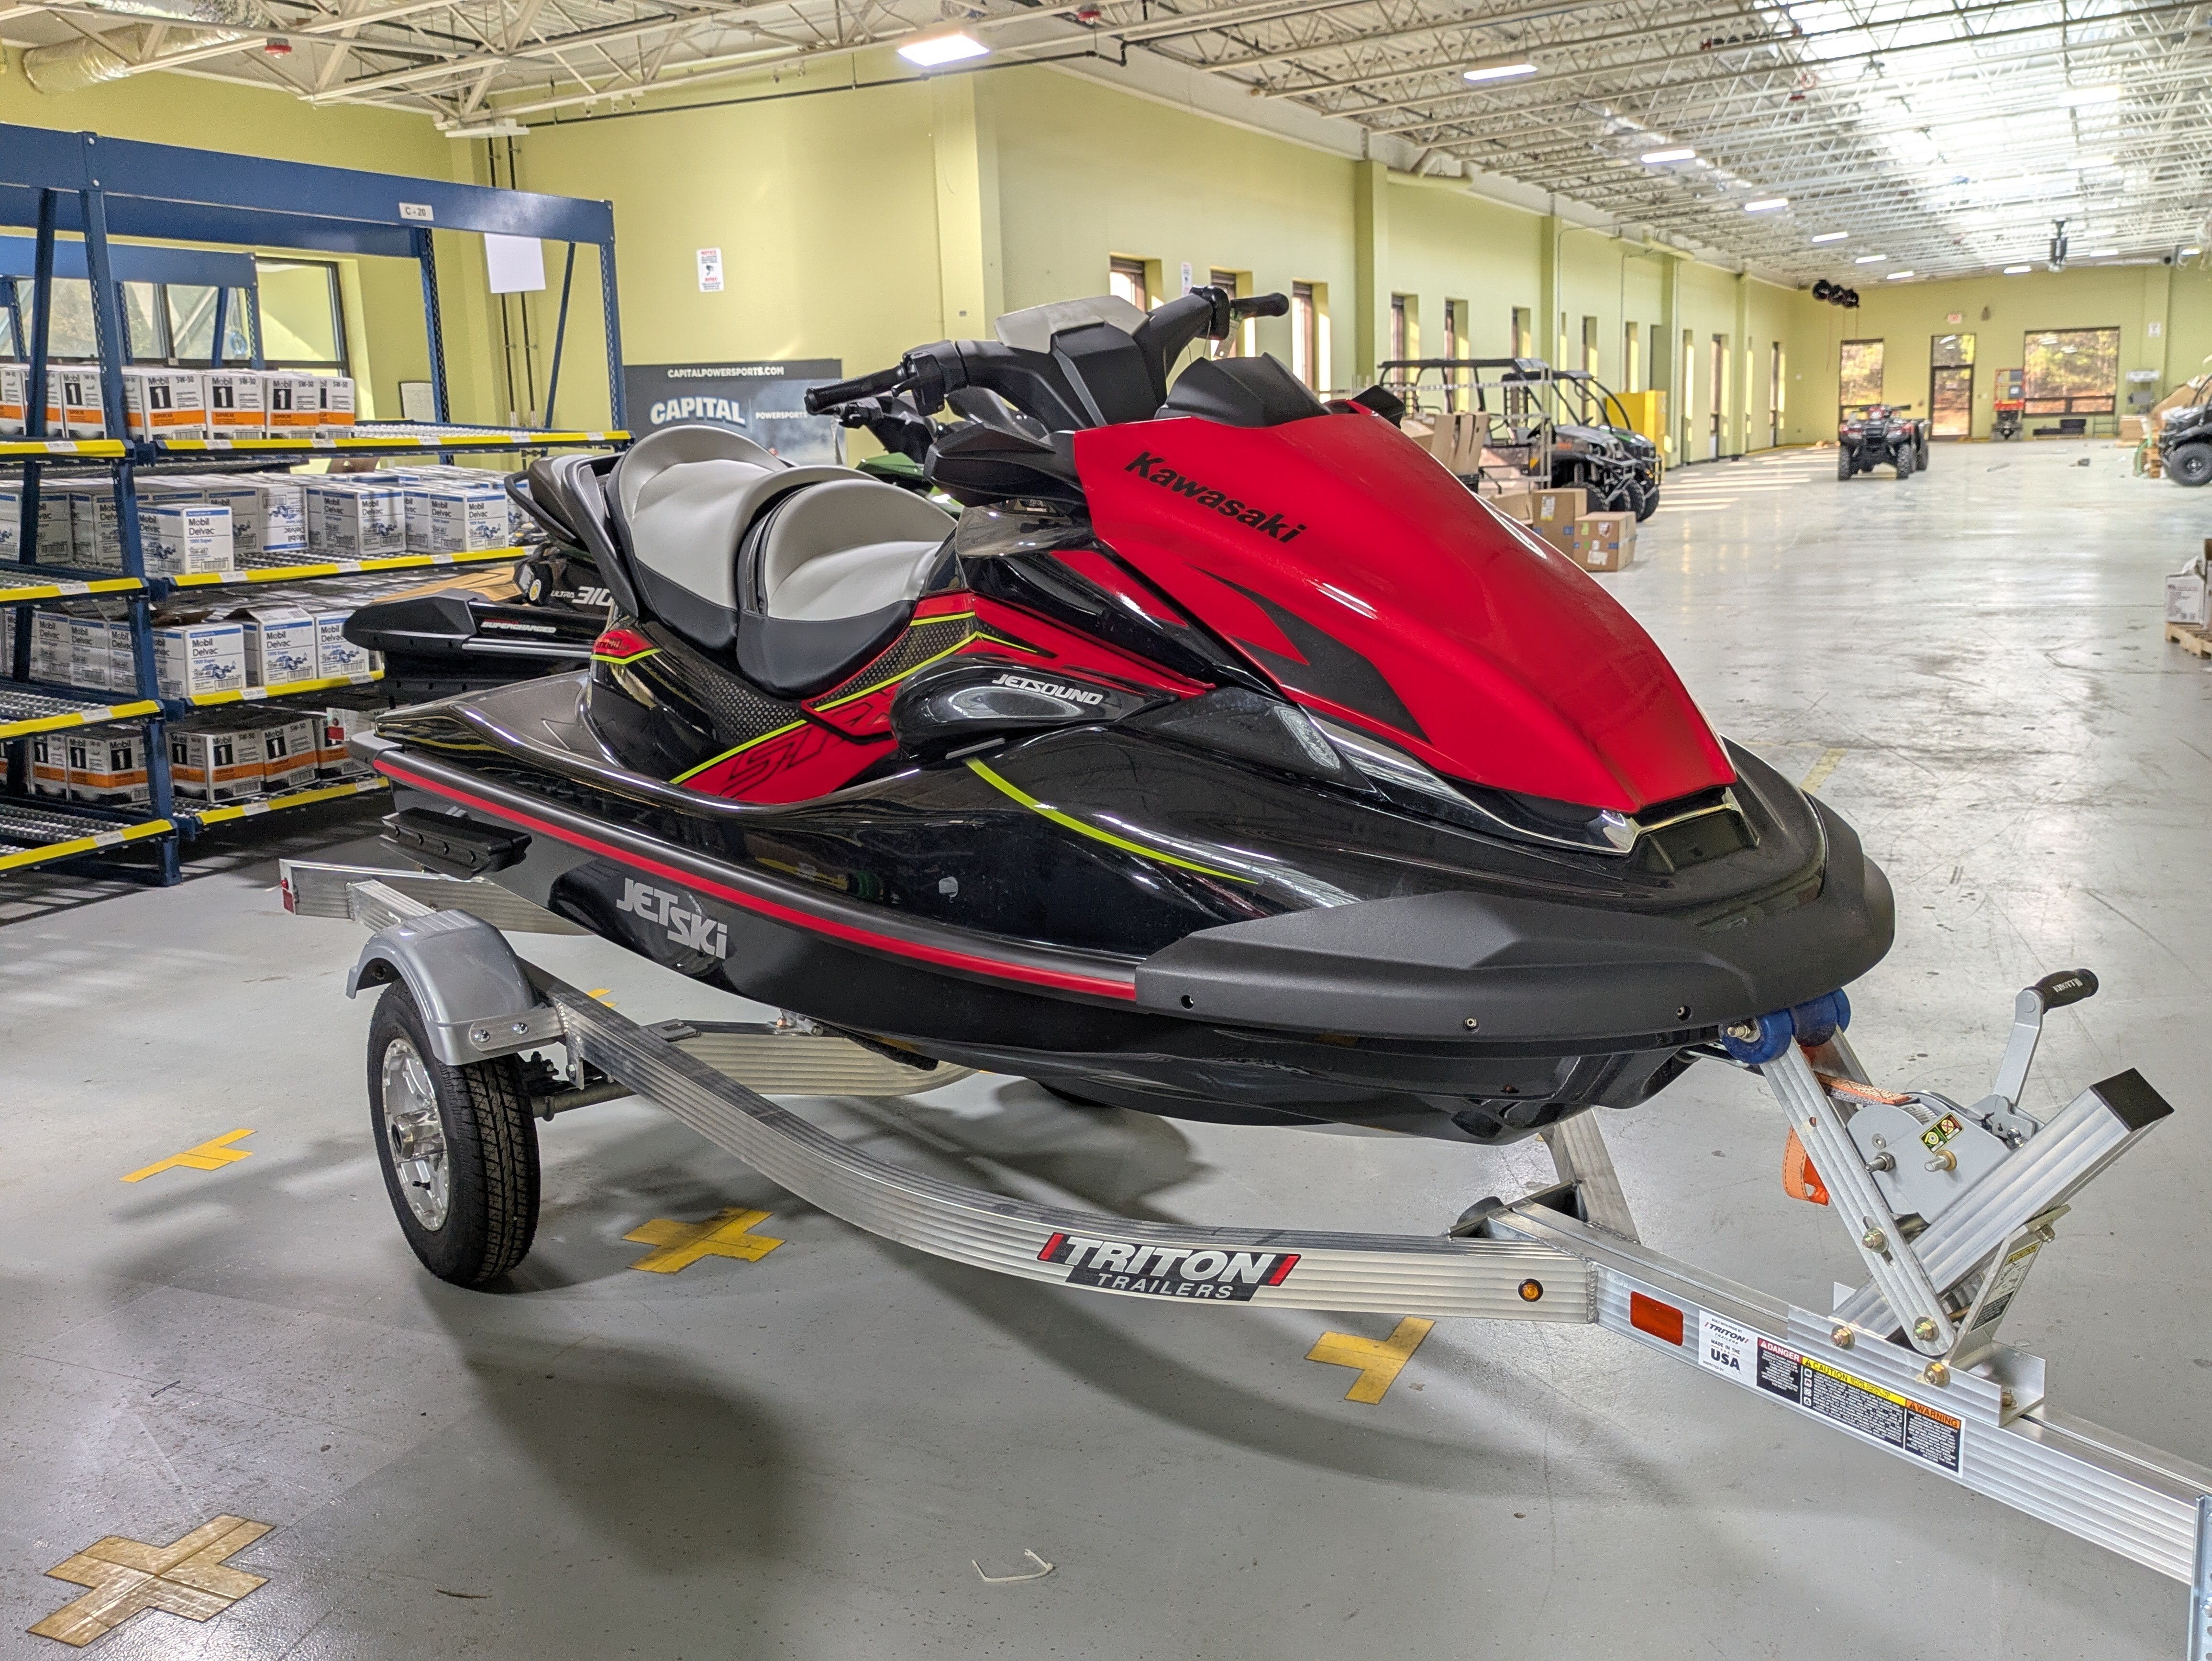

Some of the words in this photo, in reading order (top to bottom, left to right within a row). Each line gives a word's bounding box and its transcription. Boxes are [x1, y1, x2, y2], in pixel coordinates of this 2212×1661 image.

[148, 376, 169, 385] Mobil
[668, 366, 785, 378] CAPITALPOWERSPORTS.COM
[212, 377, 232, 386] Mobil
[69, 384, 77, 404] 1
[155, 388, 165, 407] 1
[219, 388, 227, 407] 1
[278, 390, 286, 409] 1
[650, 397, 746, 427] CAPITAL
[755, 411, 807, 420] POWERSPORTS
[324, 498, 340, 506] Mobil
[431, 500, 448, 509] Mobil
[1124, 451, 1307, 543] Kawasaki
[188, 518, 210, 526] Mobil
[431, 509, 452, 517] Delvac
[551, 589, 575, 599] ULTRA
[571, 586, 613, 607] 310
[39, 620, 56, 630] Mobil
[72, 626, 88, 636] Mobil
[321, 625, 340, 634] Mobil
[481, 621, 557, 634] SUPERCHARGED
[72, 635, 93, 645] Delvac
[112, 631, 129, 641] Mobil
[192, 638, 213, 647] Mobil
[266, 631, 286, 640] Mobil
[266, 640, 291, 649] Delvac
[192, 648, 219, 656] Delvac
[992, 674, 1103, 705] JETSOUND
[265, 729, 283, 739] Mobil
[37, 744, 44, 762] 1
[176, 745, 182, 763] 1
[219, 746, 227, 764] 1
[271, 739, 280, 757] 1
[75, 749, 81, 767] 1
[117, 750, 125, 768] 1
[1065, 1236, 1276, 1284] TRITON
[1097, 1273, 1234, 1298] TRAILERS
[1710, 1323, 1746, 1342] TRITON
[1714, 1333, 1739, 1345] TRAILERS
[1711, 1339, 1724, 1348] MADE
[1767, 1343, 1800, 1362] DANGER
[1711, 1348, 1740, 1371] USA
[1813, 1362, 1848, 1382] CAUTION
[1917, 1402, 1958, 1427] WARNING
